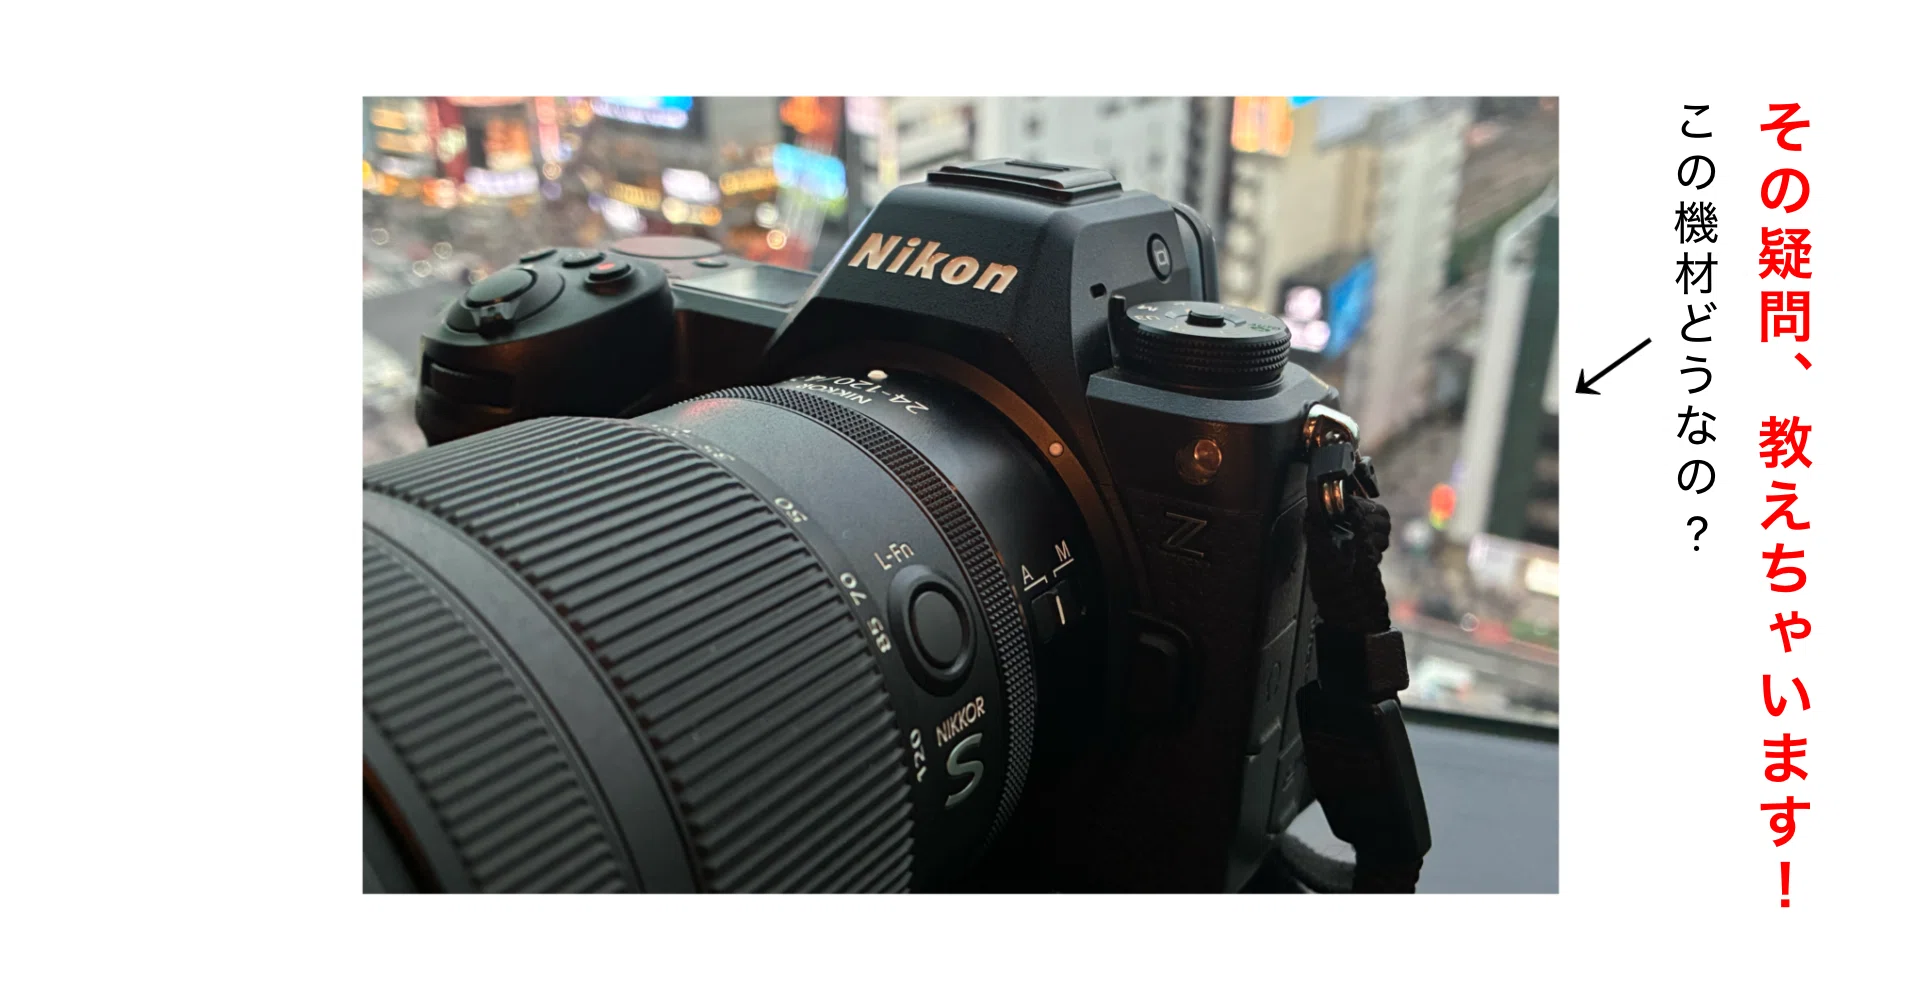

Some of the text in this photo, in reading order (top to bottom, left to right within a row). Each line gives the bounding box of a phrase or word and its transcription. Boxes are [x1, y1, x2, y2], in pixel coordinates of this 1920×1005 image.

[847, 232, 1018, 294] Nikon
[795, 383, 873, 405] NIKKOR
[774, 497, 808, 523] 50
[873, 543, 915, 571] L-Fn
[1054, 539, 1071, 562] M
[840, 572, 867, 606] 70
[1021, 564, 1034, 585] A
[866, 617, 892, 653] 85
[935, 696, 986, 747] NIKKOR
[909, 728, 927, 783] 120
[944, 732, 985, 808] S
